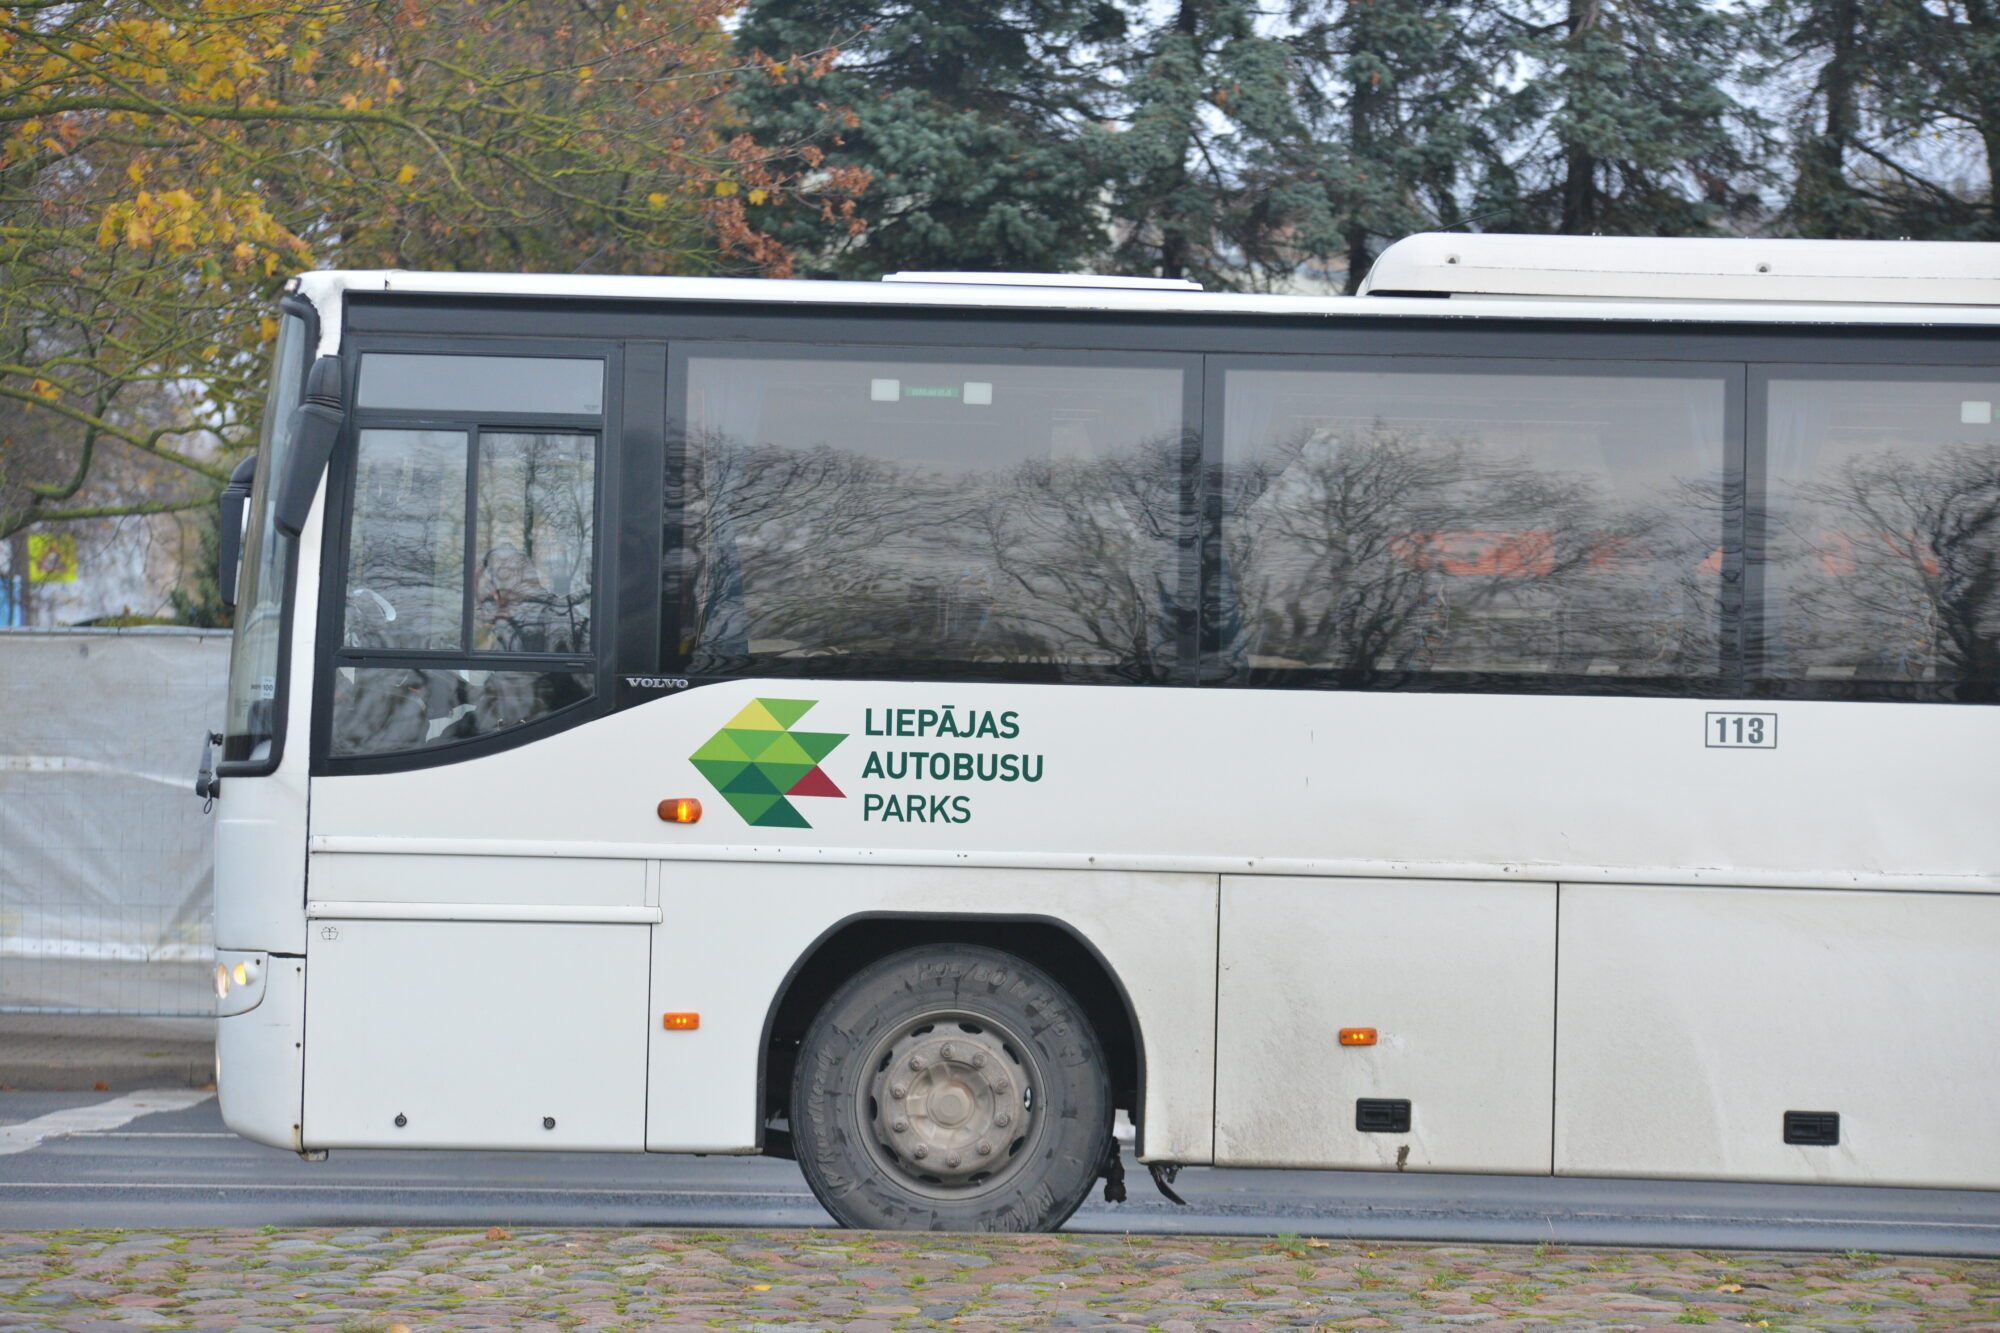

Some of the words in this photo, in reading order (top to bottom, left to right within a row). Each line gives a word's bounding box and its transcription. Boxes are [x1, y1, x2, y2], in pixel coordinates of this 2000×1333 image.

[625, 677, 689, 689] VOLVO
[865, 705, 1020, 739] LIEPĀJAS
[1716, 717, 1764, 744] 113
[862, 751, 1044, 782] AUTOBUSU
[863, 794, 971, 824] PARKS
